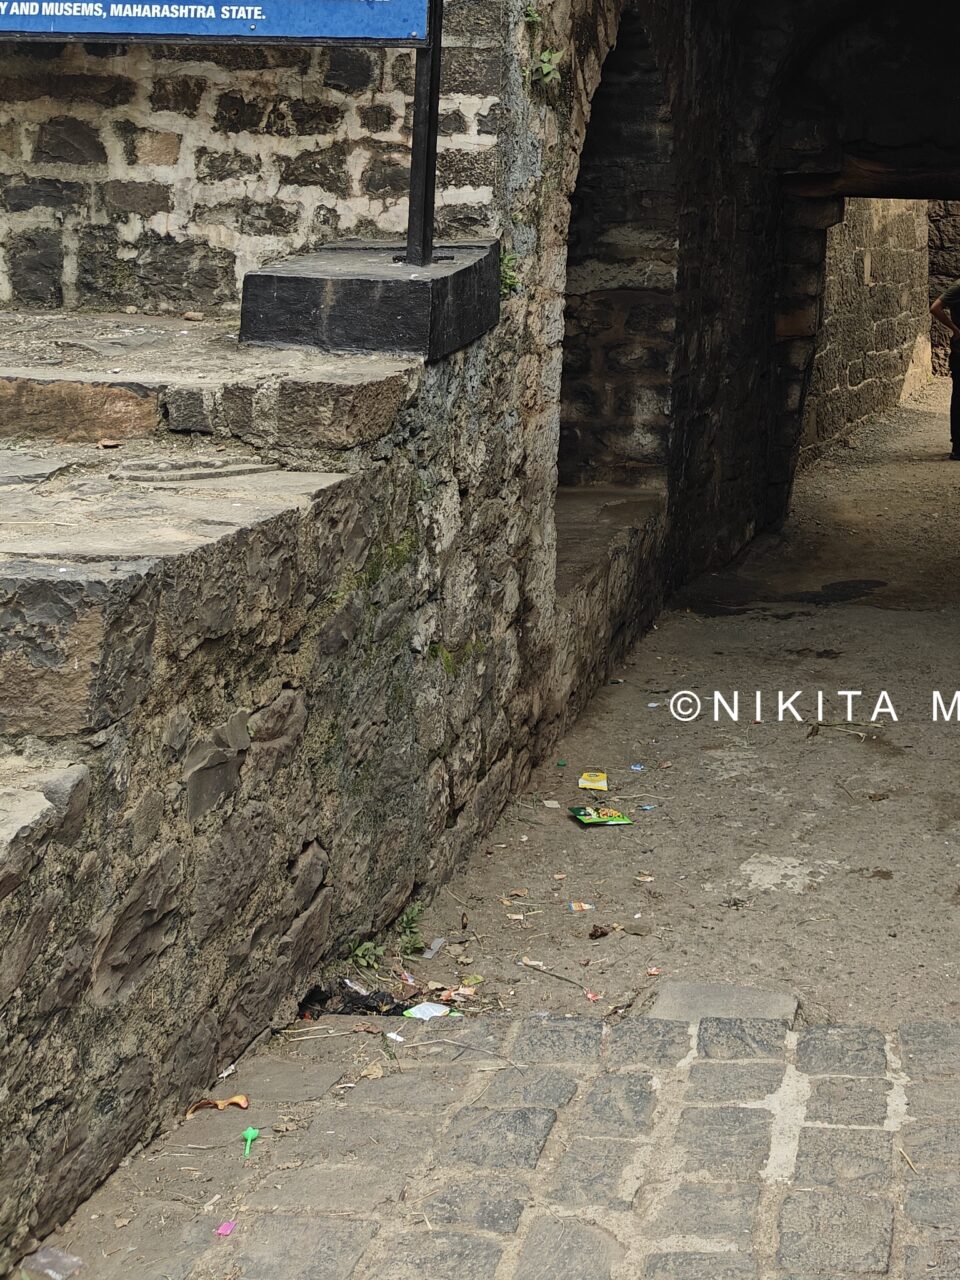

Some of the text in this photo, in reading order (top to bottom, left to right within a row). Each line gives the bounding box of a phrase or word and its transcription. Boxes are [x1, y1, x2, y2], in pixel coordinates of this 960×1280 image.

[9, 1, 266, 20] AND MUSEMS, MAHARASHTRA STATE.
